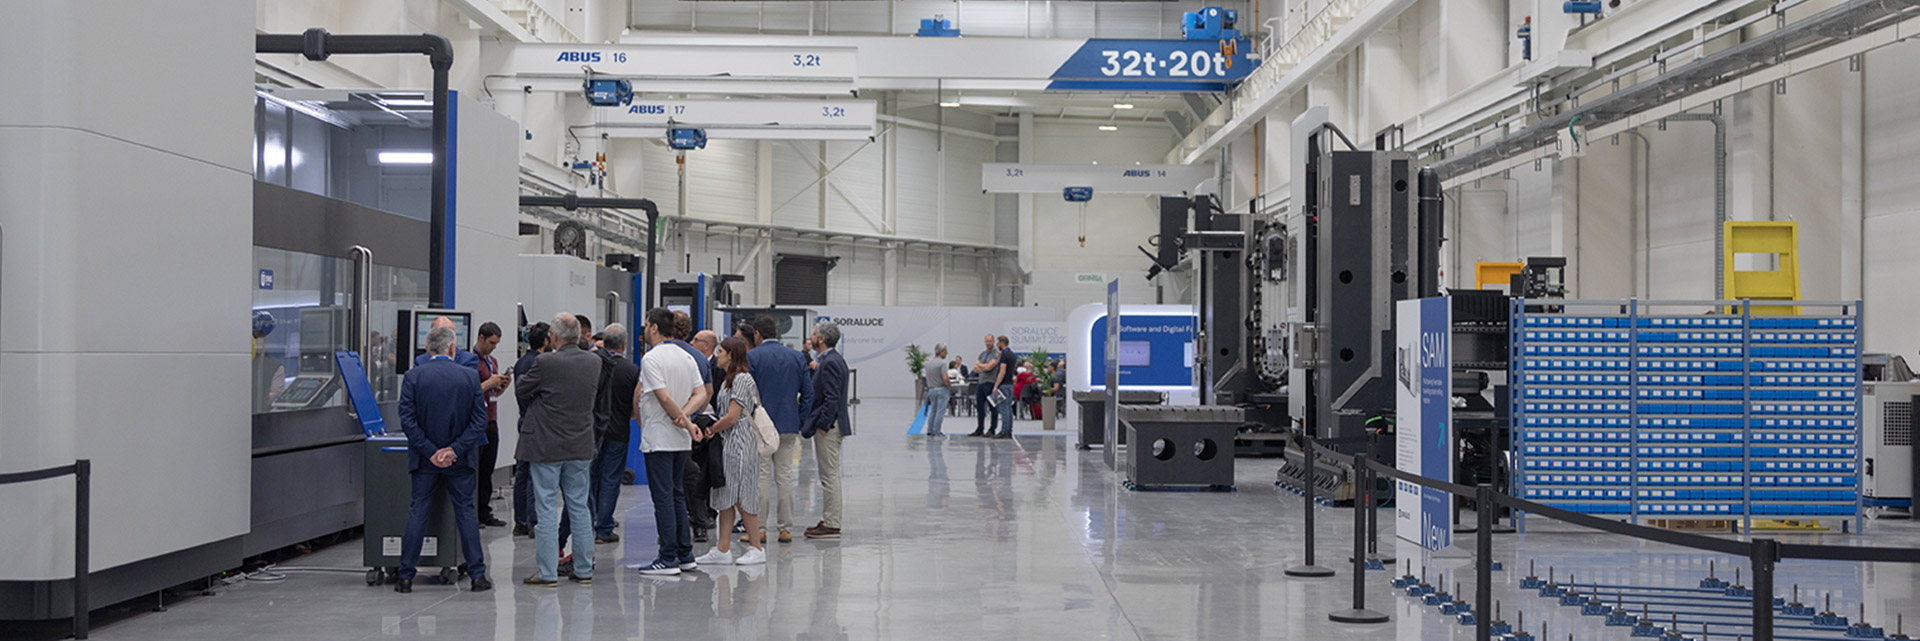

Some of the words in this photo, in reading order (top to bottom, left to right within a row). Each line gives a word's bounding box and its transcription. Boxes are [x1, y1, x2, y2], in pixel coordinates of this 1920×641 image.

[557, 52, 601, 62] ABUS
[613, 53, 627, 63] 16
[793, 54, 821, 67] 3,2t
[629, 105, 664, 114] ABUS
[674, 106, 685, 114] 17
[822, 106, 845, 117] 3,2t
[1006, 168, 1023, 177] 3,2t
[833, 318, 884, 326] SORALUCE
[1011, 327, 1058, 335] SORALUCE
[1163, 325, 1184, 334] Digital
[1011, 336, 1046, 344] SUMMIT
[1422, 332, 1445, 368] SAM
[1423, 511, 1447, 551] New
